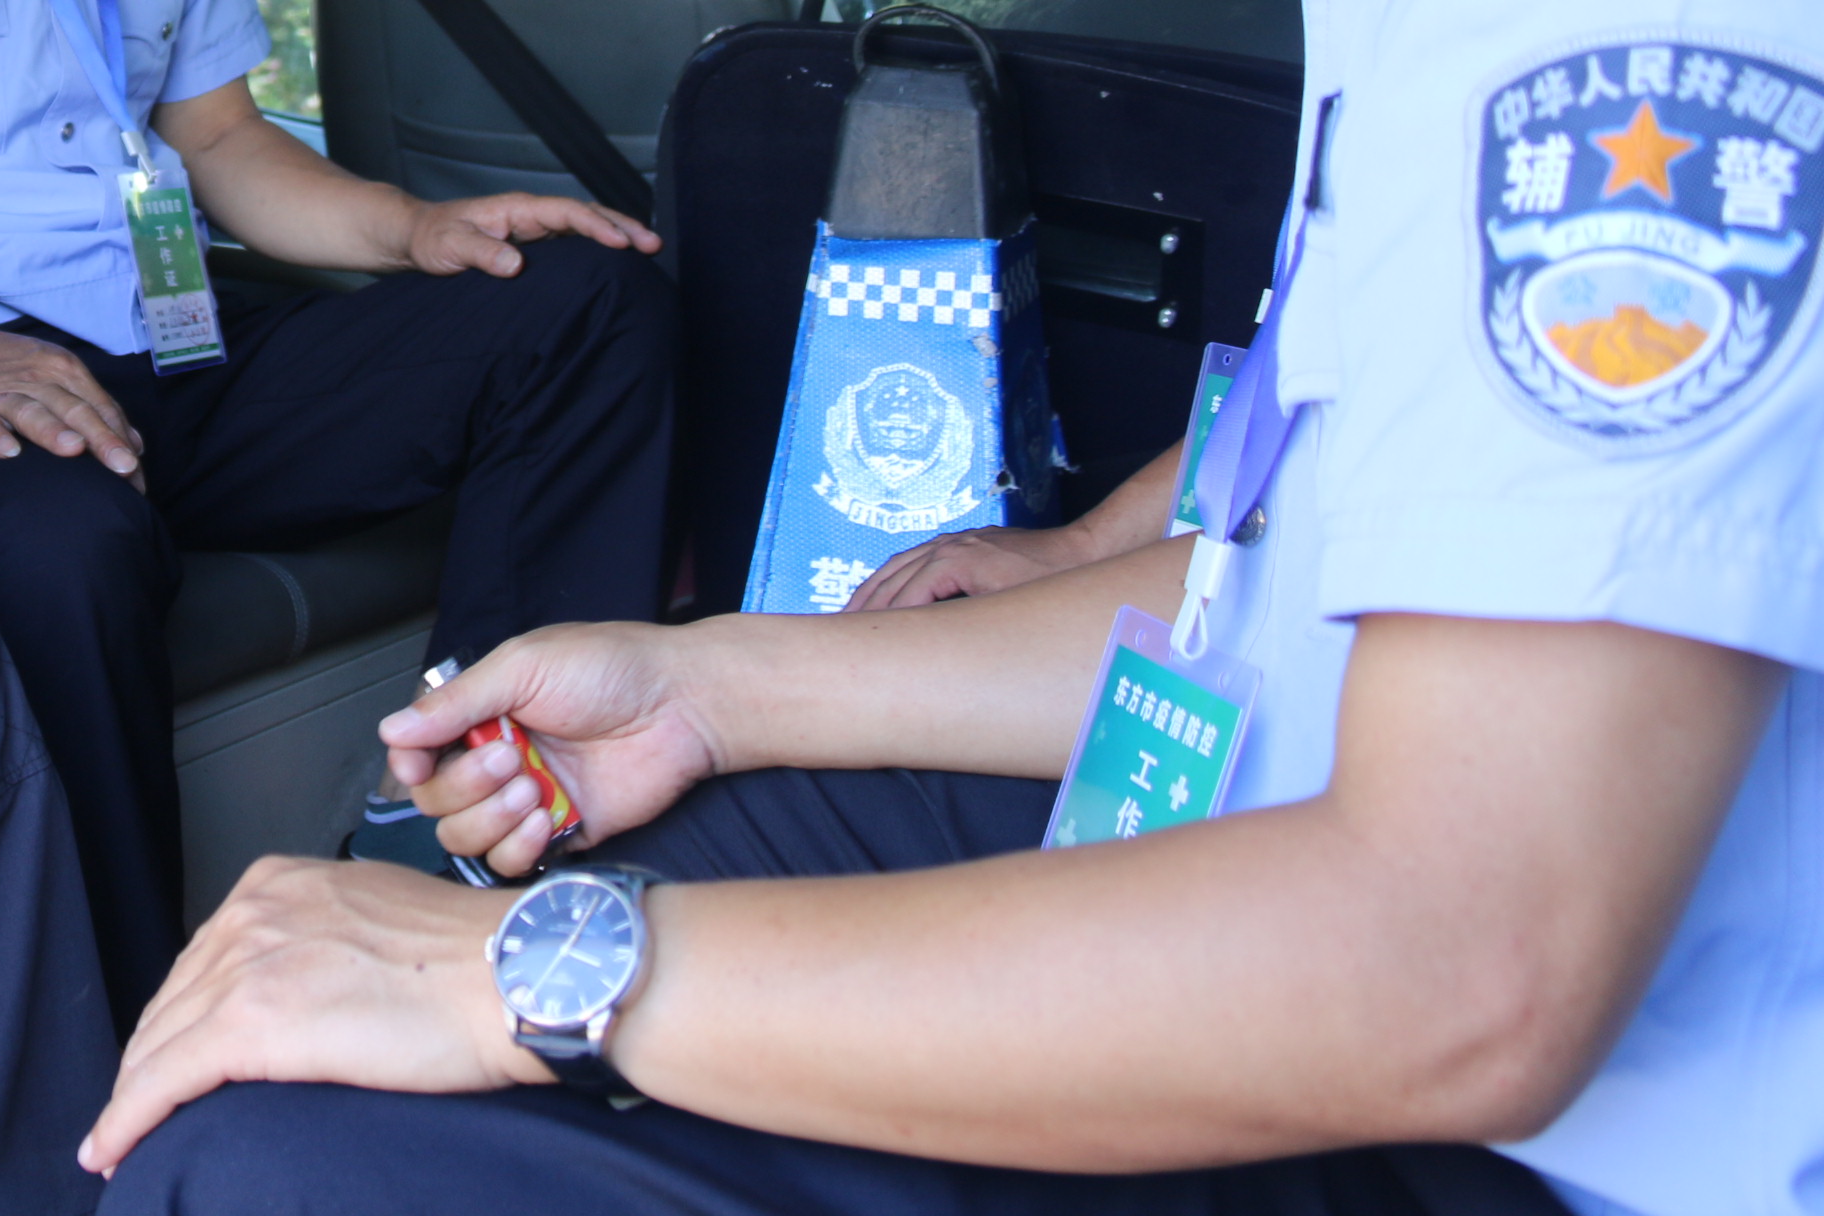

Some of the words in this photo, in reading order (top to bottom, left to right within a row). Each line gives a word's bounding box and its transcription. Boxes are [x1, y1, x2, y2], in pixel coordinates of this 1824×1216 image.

[1492, 46, 1824, 154] 中华人民共和国
[851, 504, 935, 531] JINGCHA
[1113, 675, 1218, 759] 东方市疫情防控
